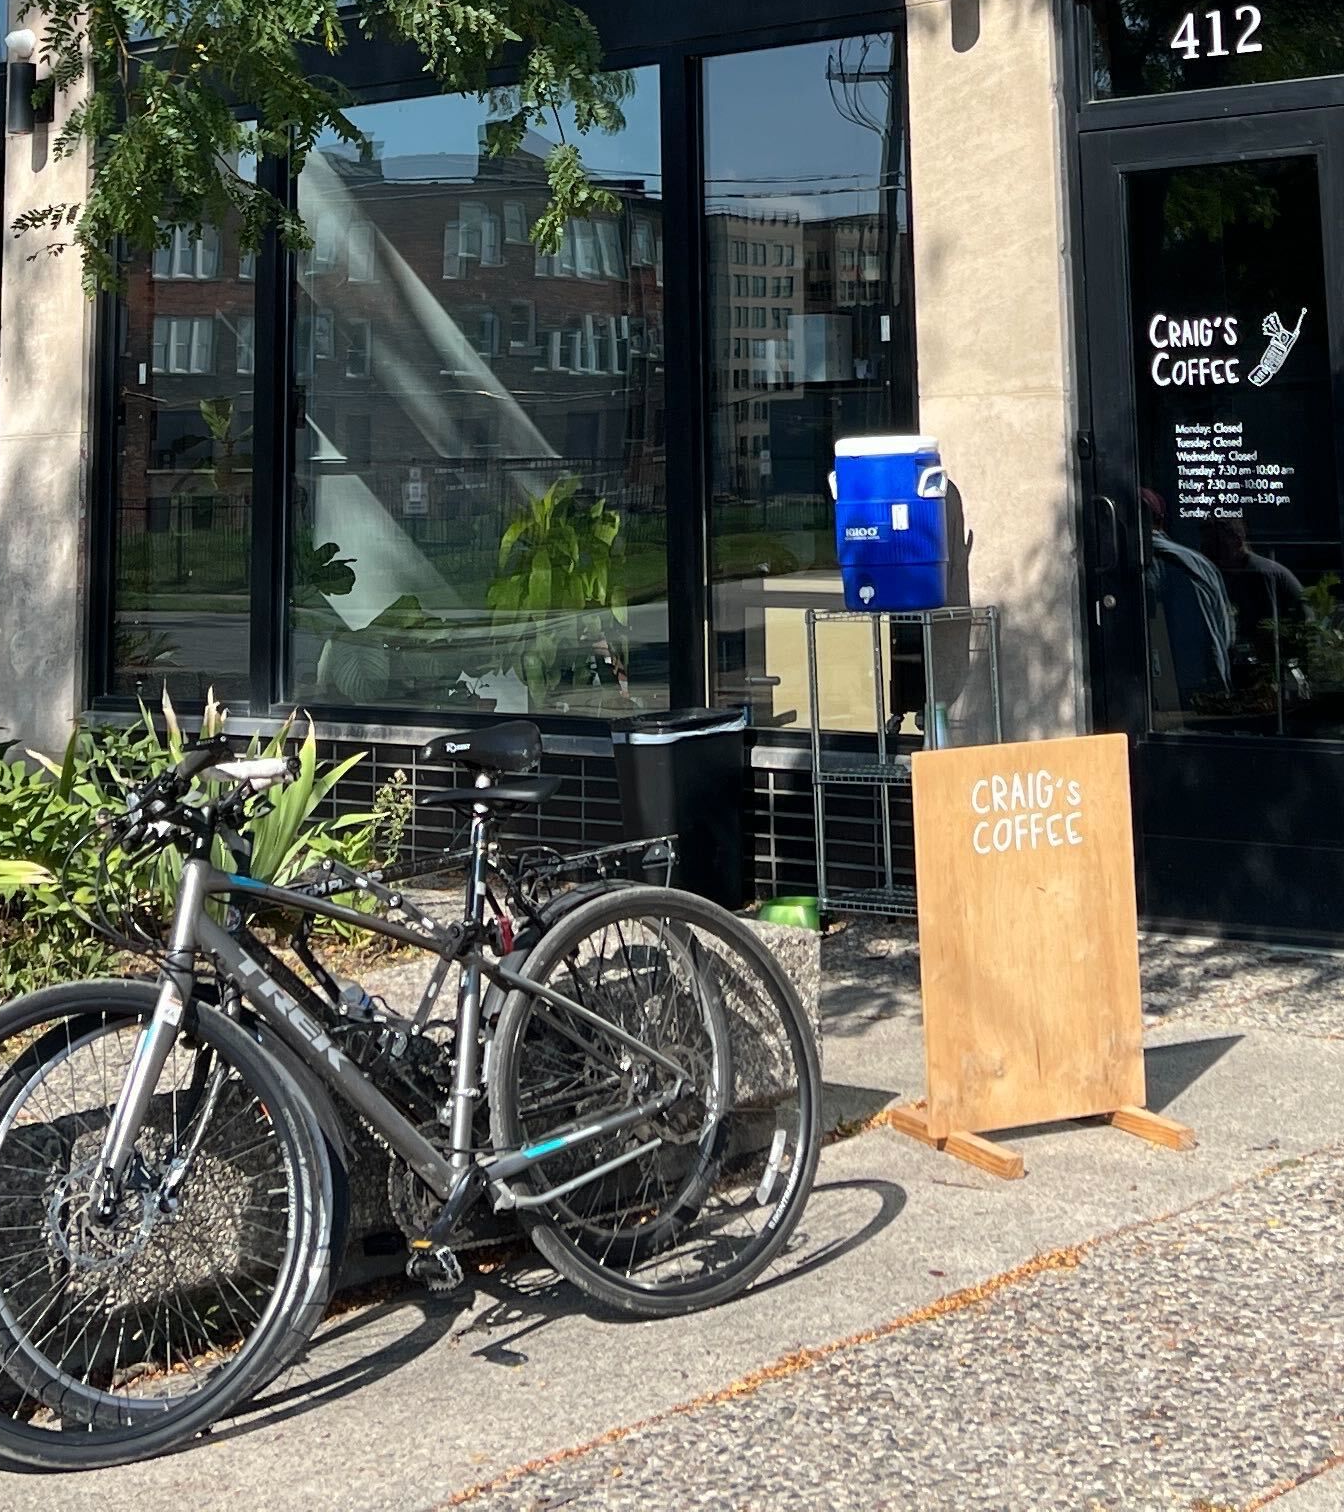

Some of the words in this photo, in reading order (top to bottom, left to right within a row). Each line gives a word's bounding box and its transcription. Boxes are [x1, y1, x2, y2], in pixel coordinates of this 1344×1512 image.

[1170, 5, 1263, 60] 412
[1149, 314, 1238, 348] CRAIG'S
[1151, 352, 1240, 387] COFFEE
[1175, 422, 1212, 436] Monday:
[1213, 421, 1243, 434] Closed
[1175, 436, 1211, 450] Tuesday:
[1213, 435, 1243, 448] Closed
[1176, 450, 1226, 464] Wednesday:
[1228, 449, 1258, 462] Closed
[1177, 464, 1216, 478] Thursday:
[1218, 464, 1237, 476] 7:30
[1281, 466, 1295, 476] am
[1178, 478, 1205, 492] Friday:
[1207, 478, 1226, 490] 7:30
[1269, 480, 1284, 490] am
[1178, 492, 1216, 506] Saturday:
[1218, 493, 1239, 504] 9:00
[1275, 494, 1291, 506] pm
[1179, 506, 1212, 520] Sunday:
[1213, 506, 1244, 519] Closed
[973, 811, 1084, 855] COFFEE
[238, 947, 352, 1073] TREK
